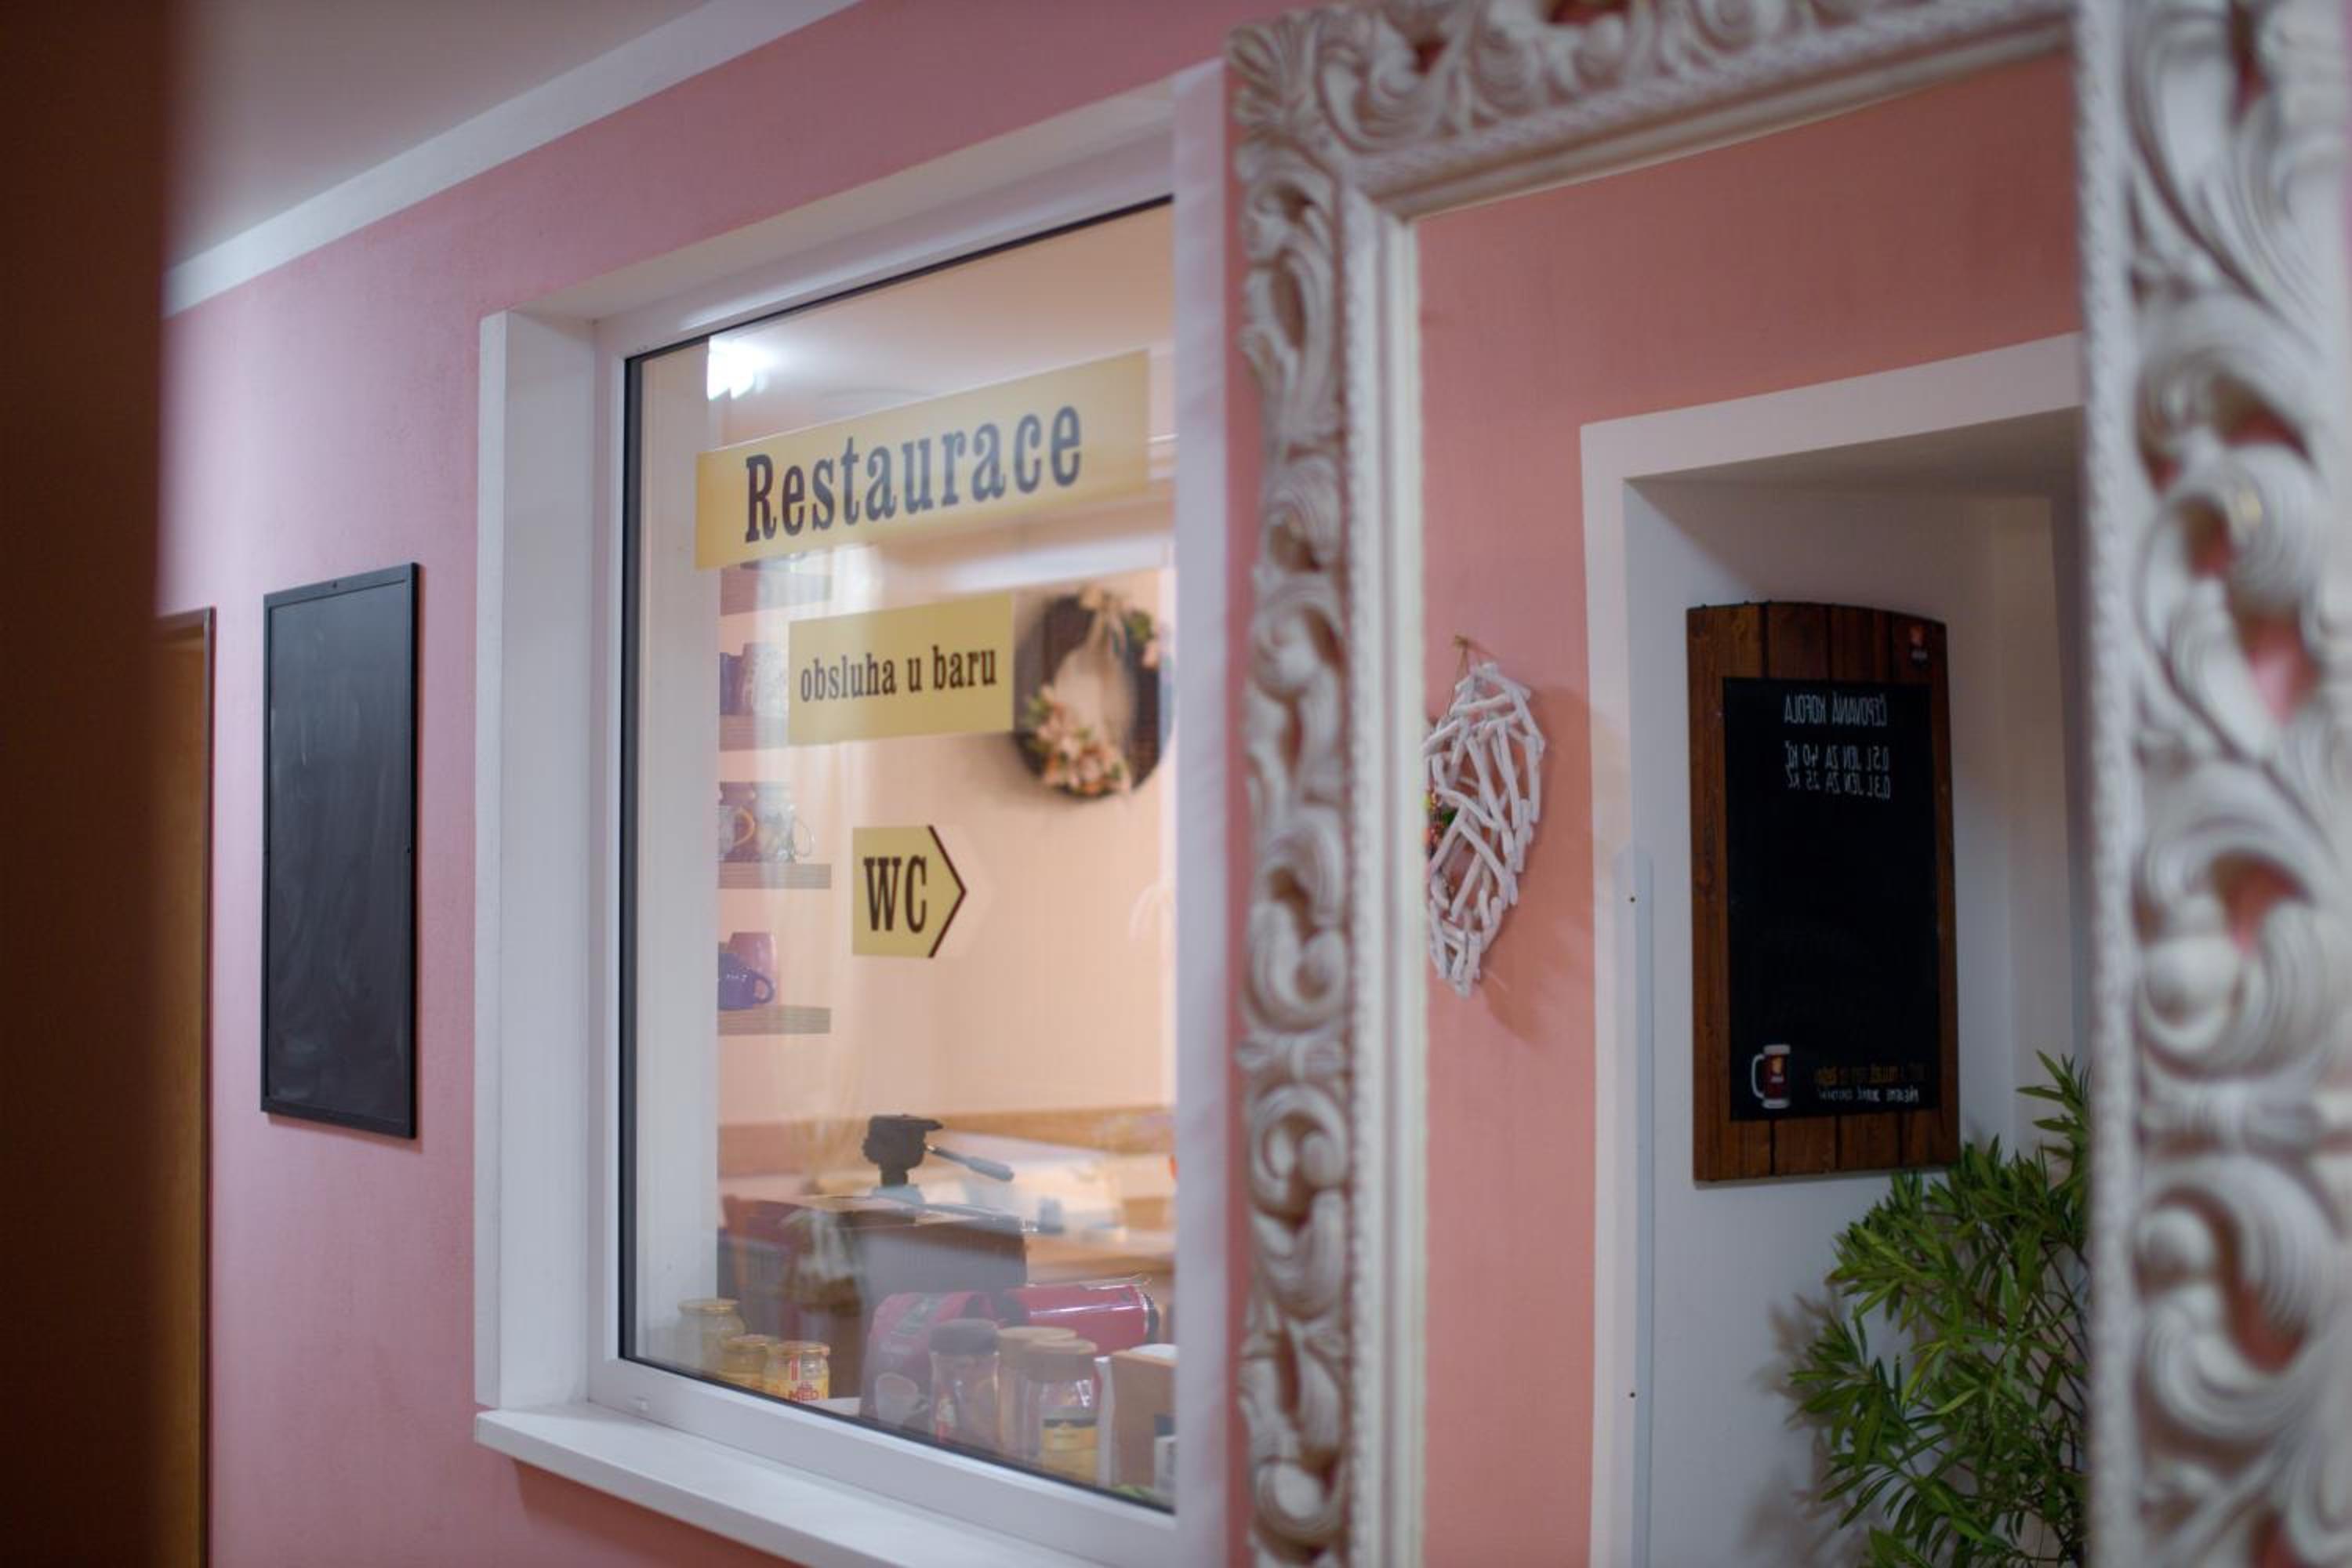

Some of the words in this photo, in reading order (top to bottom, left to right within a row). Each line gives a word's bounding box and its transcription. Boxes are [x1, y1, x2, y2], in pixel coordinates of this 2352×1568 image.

[745, 405, 1082, 543] Restaurace
[800, 653, 896, 702] obsluha
[907, 656, 923, 692] u
[932, 644, 996, 690] baru
[863, 855, 927, 933] WC
